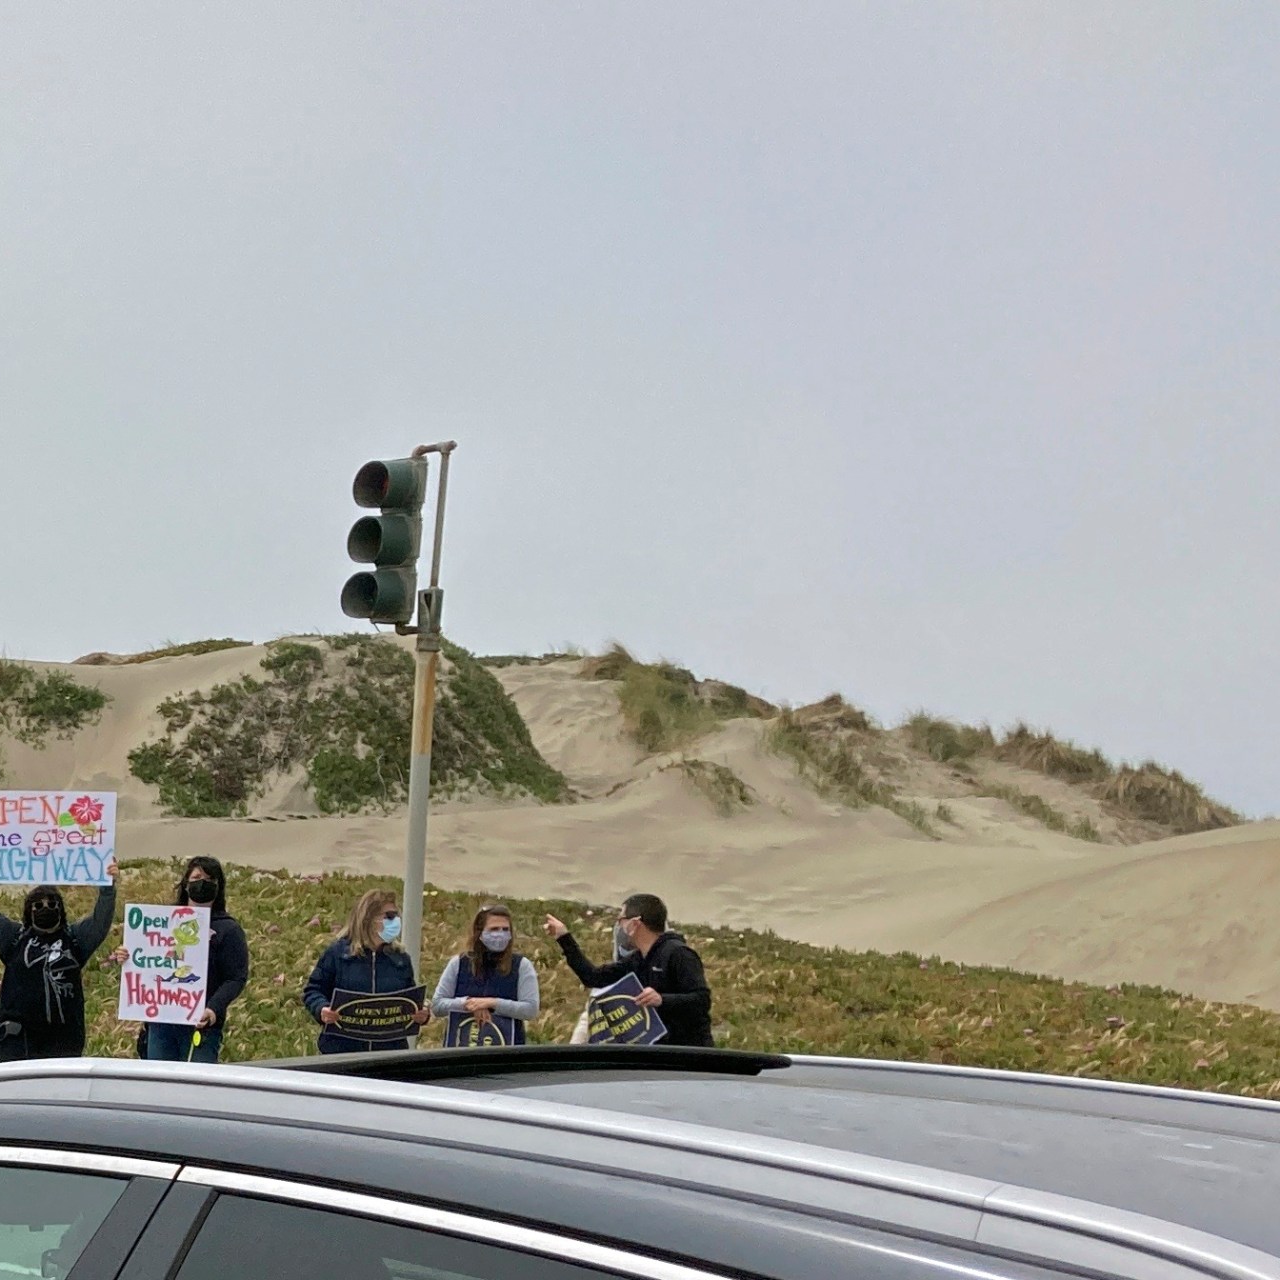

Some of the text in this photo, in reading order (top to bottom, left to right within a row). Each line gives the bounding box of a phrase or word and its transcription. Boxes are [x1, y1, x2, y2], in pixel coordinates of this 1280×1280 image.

[32, 823, 107, 857] great
[128, 907, 169, 934] Open
[144, 931, 177, 947] The
[124, 972, 204, 1021] Highway
[354, 1007, 381, 1015] OPEN
